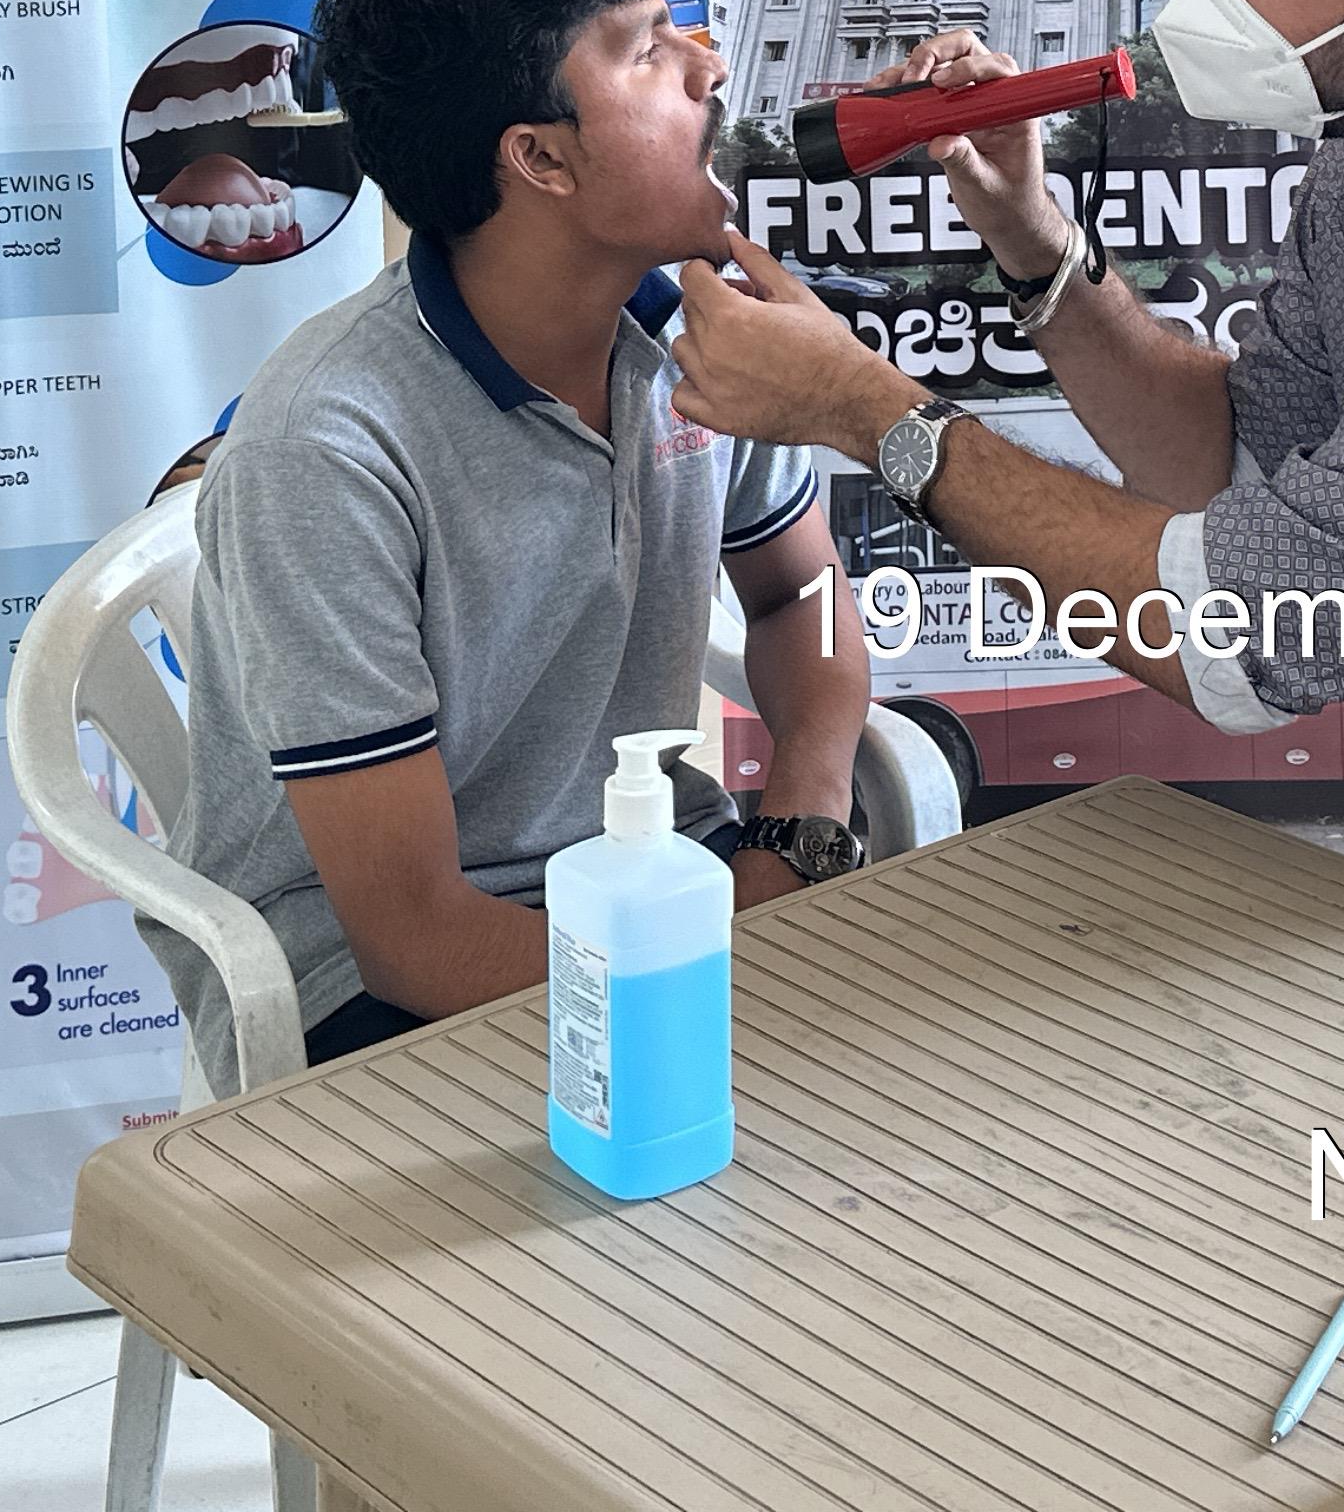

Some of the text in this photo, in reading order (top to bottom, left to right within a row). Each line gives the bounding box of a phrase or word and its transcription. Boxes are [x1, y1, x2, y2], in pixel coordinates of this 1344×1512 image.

[746, 174, 983, 255] FREE
[10, 963, 53, 1017] 3
[56, 962, 108, 984] Inner
[57, 986, 140, 1013] surfaces
[58, 1004, 180, 1040] are cleaned
